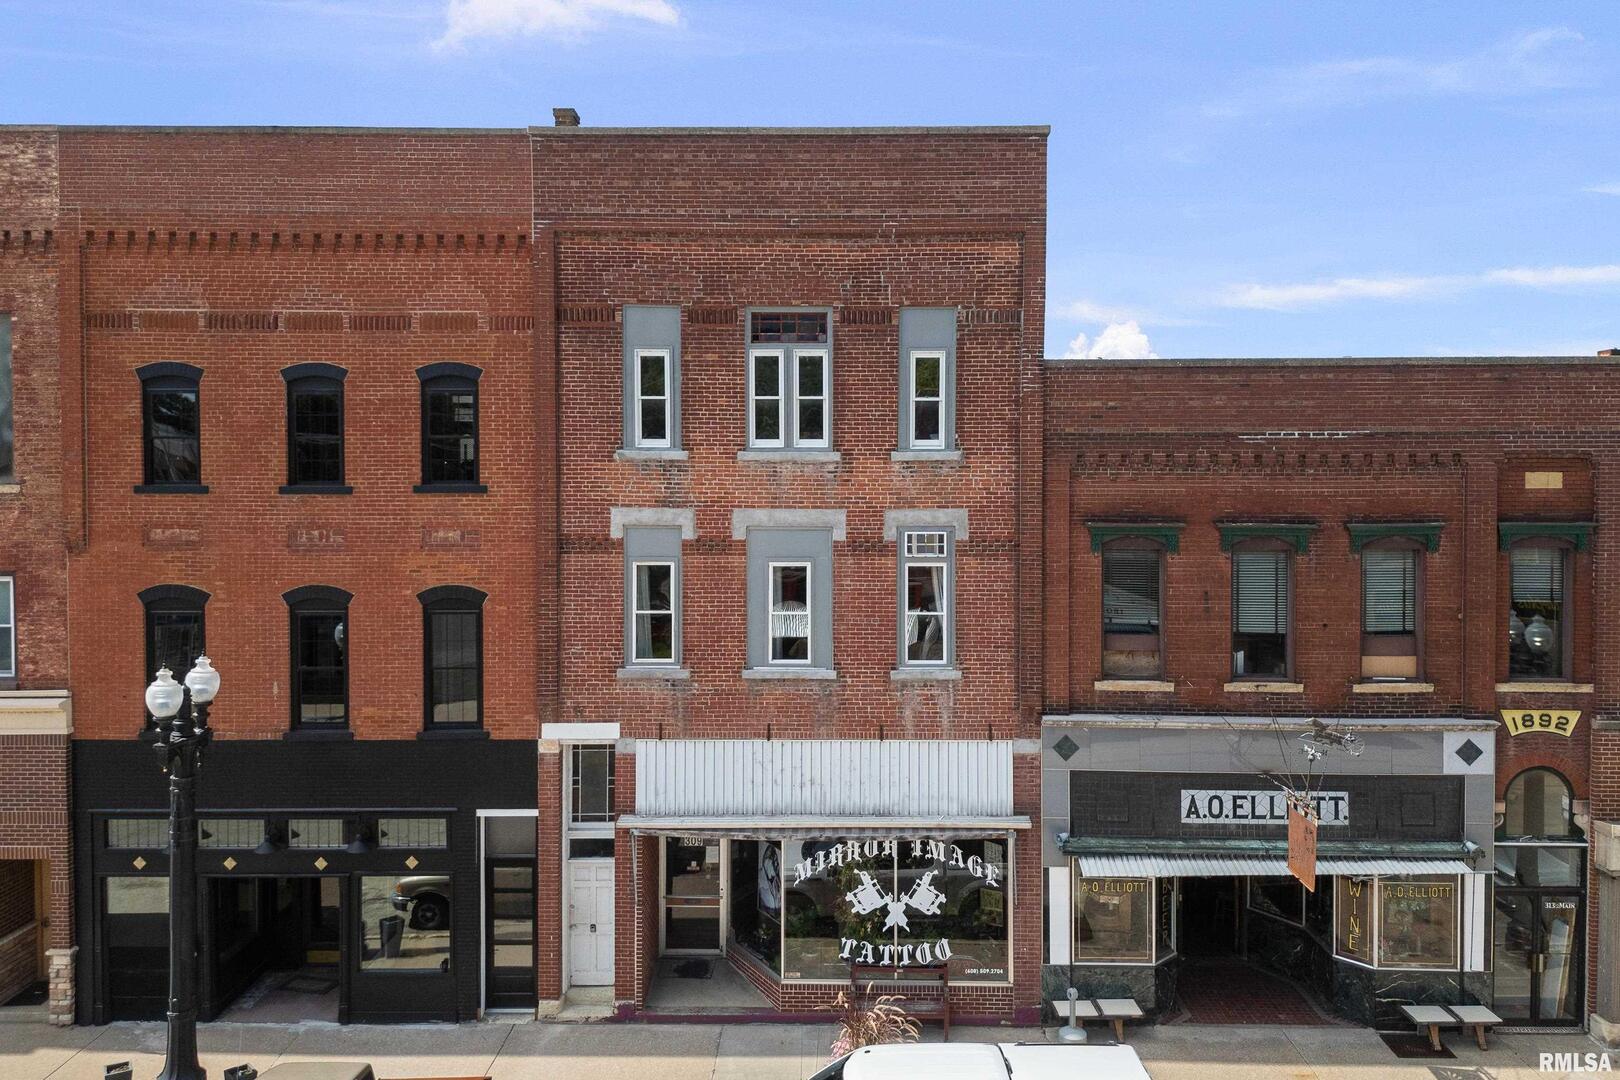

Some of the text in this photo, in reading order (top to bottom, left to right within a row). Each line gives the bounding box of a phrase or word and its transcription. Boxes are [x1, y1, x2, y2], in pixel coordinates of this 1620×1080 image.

[1512, 713, 1569, 732] 1892
[684, 837, 703, 846] 309
[911, 839, 1000, 888] IMAGE
[1347, 879, 1362, 951] WINE
[838, 937, 953, 967] TATTOO
